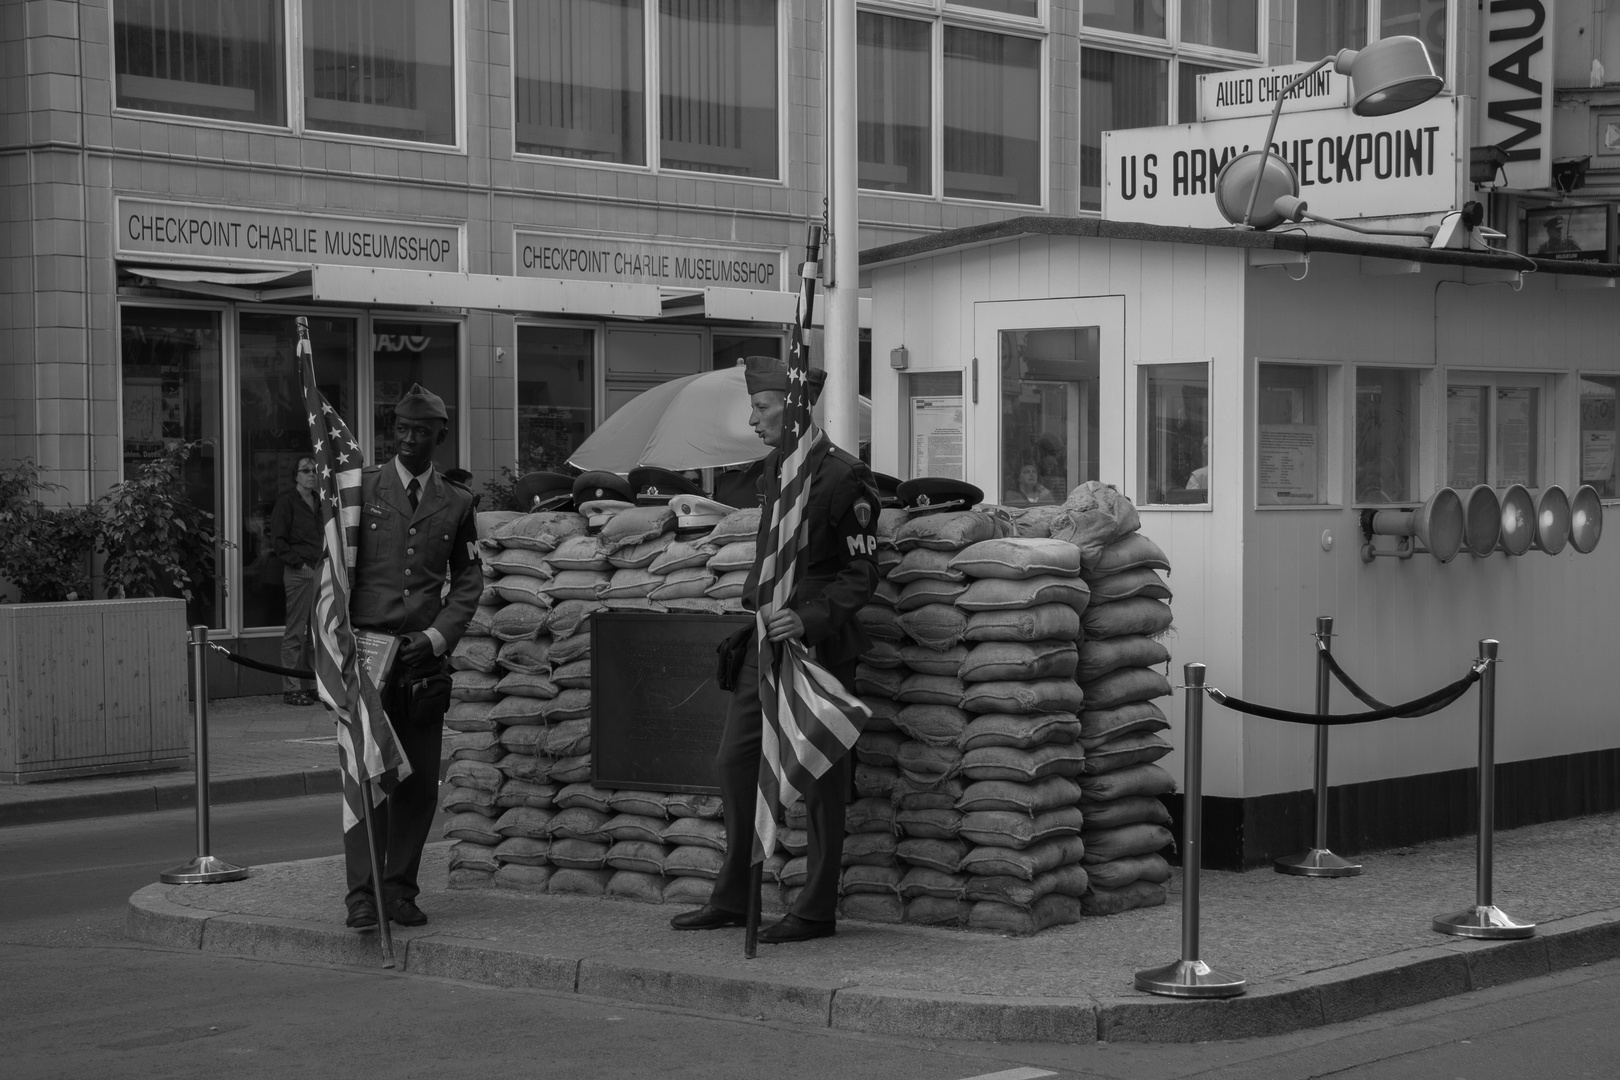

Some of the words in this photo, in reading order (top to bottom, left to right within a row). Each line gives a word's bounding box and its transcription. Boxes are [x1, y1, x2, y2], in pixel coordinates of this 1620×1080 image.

[1216, 78, 1253, 107] ALLIED
[1173, 144, 1249, 197] ARM
[128, 214, 241, 248] CHECKPOINT
[247, 224, 318, 253] CHARLIE
[325, 230, 450, 262] MUSEUMSSHOP
[522, 245, 610, 273] CHECKPOINT
[614, 252, 669, 277] CHARLIE
[675, 257, 774, 284] MUSEUMSSHOP
[846, 533, 877, 557] MP
